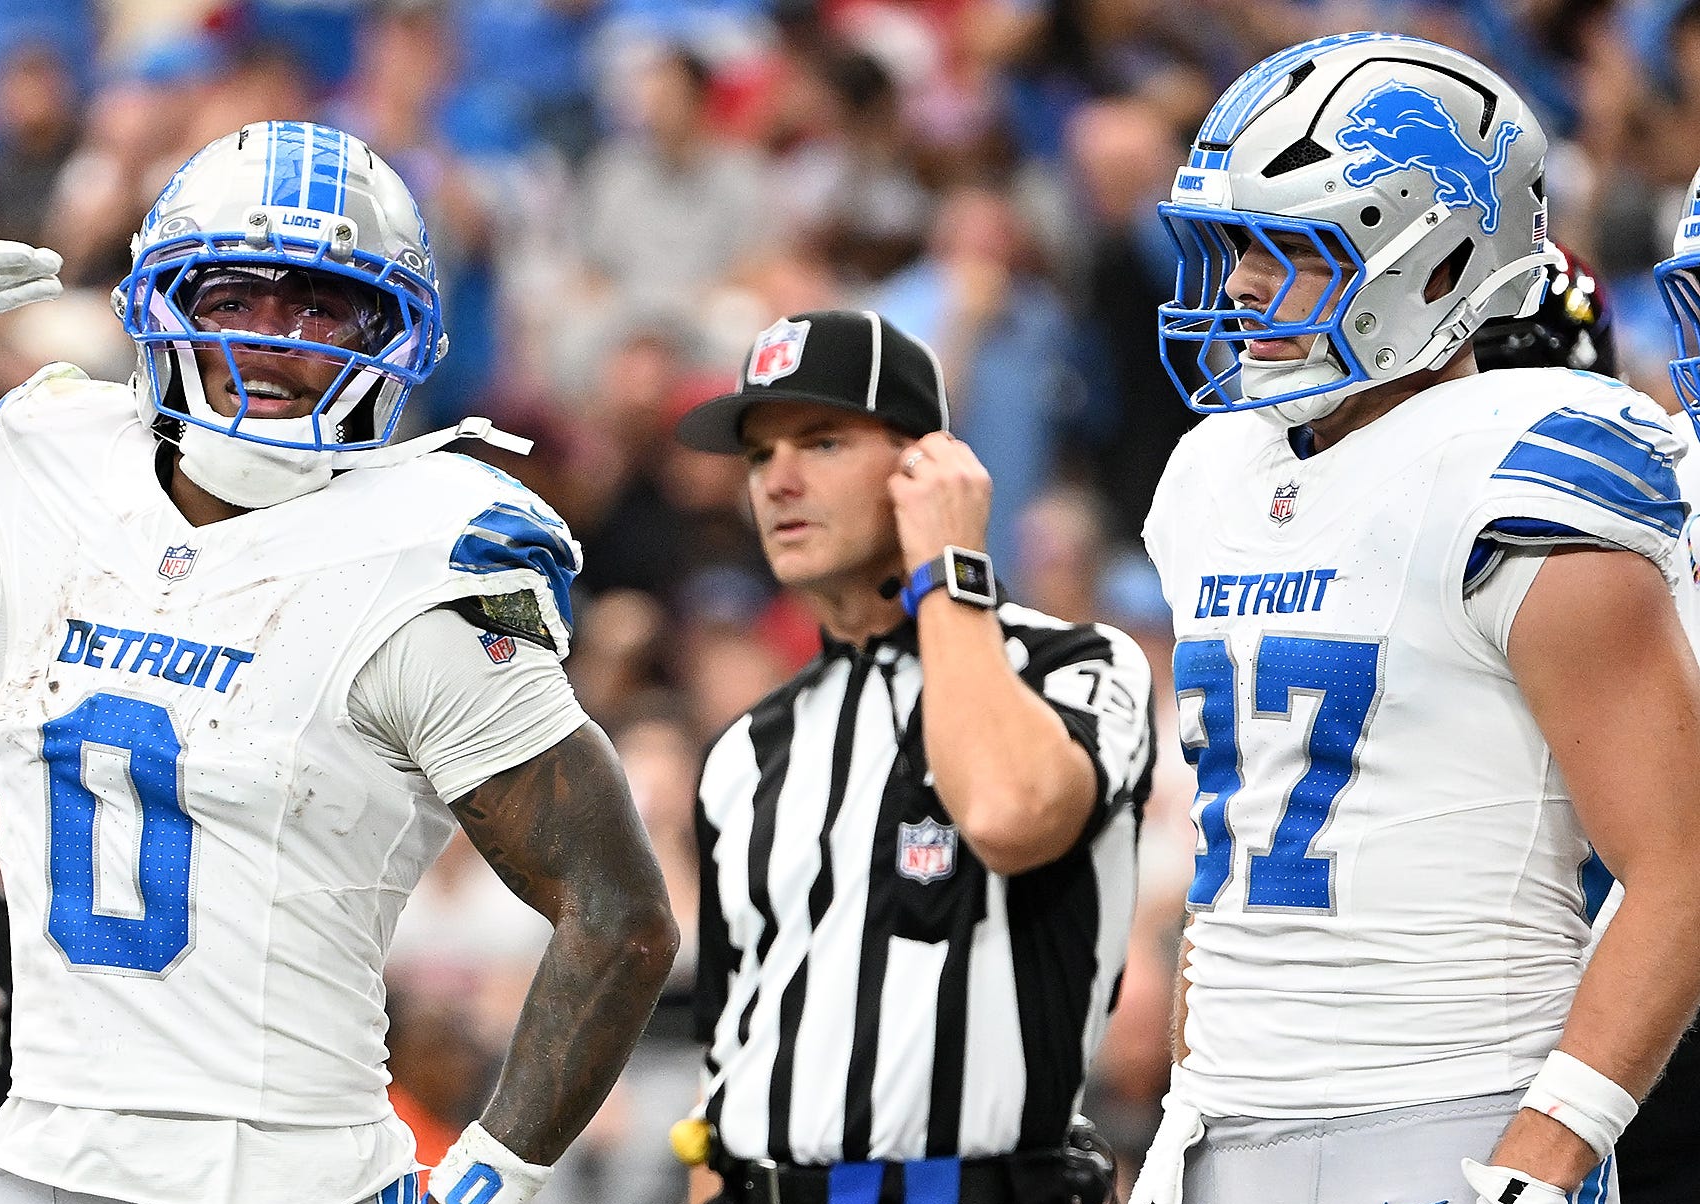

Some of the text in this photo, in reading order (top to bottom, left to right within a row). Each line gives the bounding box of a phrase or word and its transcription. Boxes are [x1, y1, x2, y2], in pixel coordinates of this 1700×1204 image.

[282, 213, 322, 230] LIONS
[1272, 499, 1292, 518] NFL
[162, 559, 188, 576] NFL
[1194, 569, 1338, 619] DETROIT
[56, 618, 256, 694] DETROIT
[38, 686, 202, 981] 0
